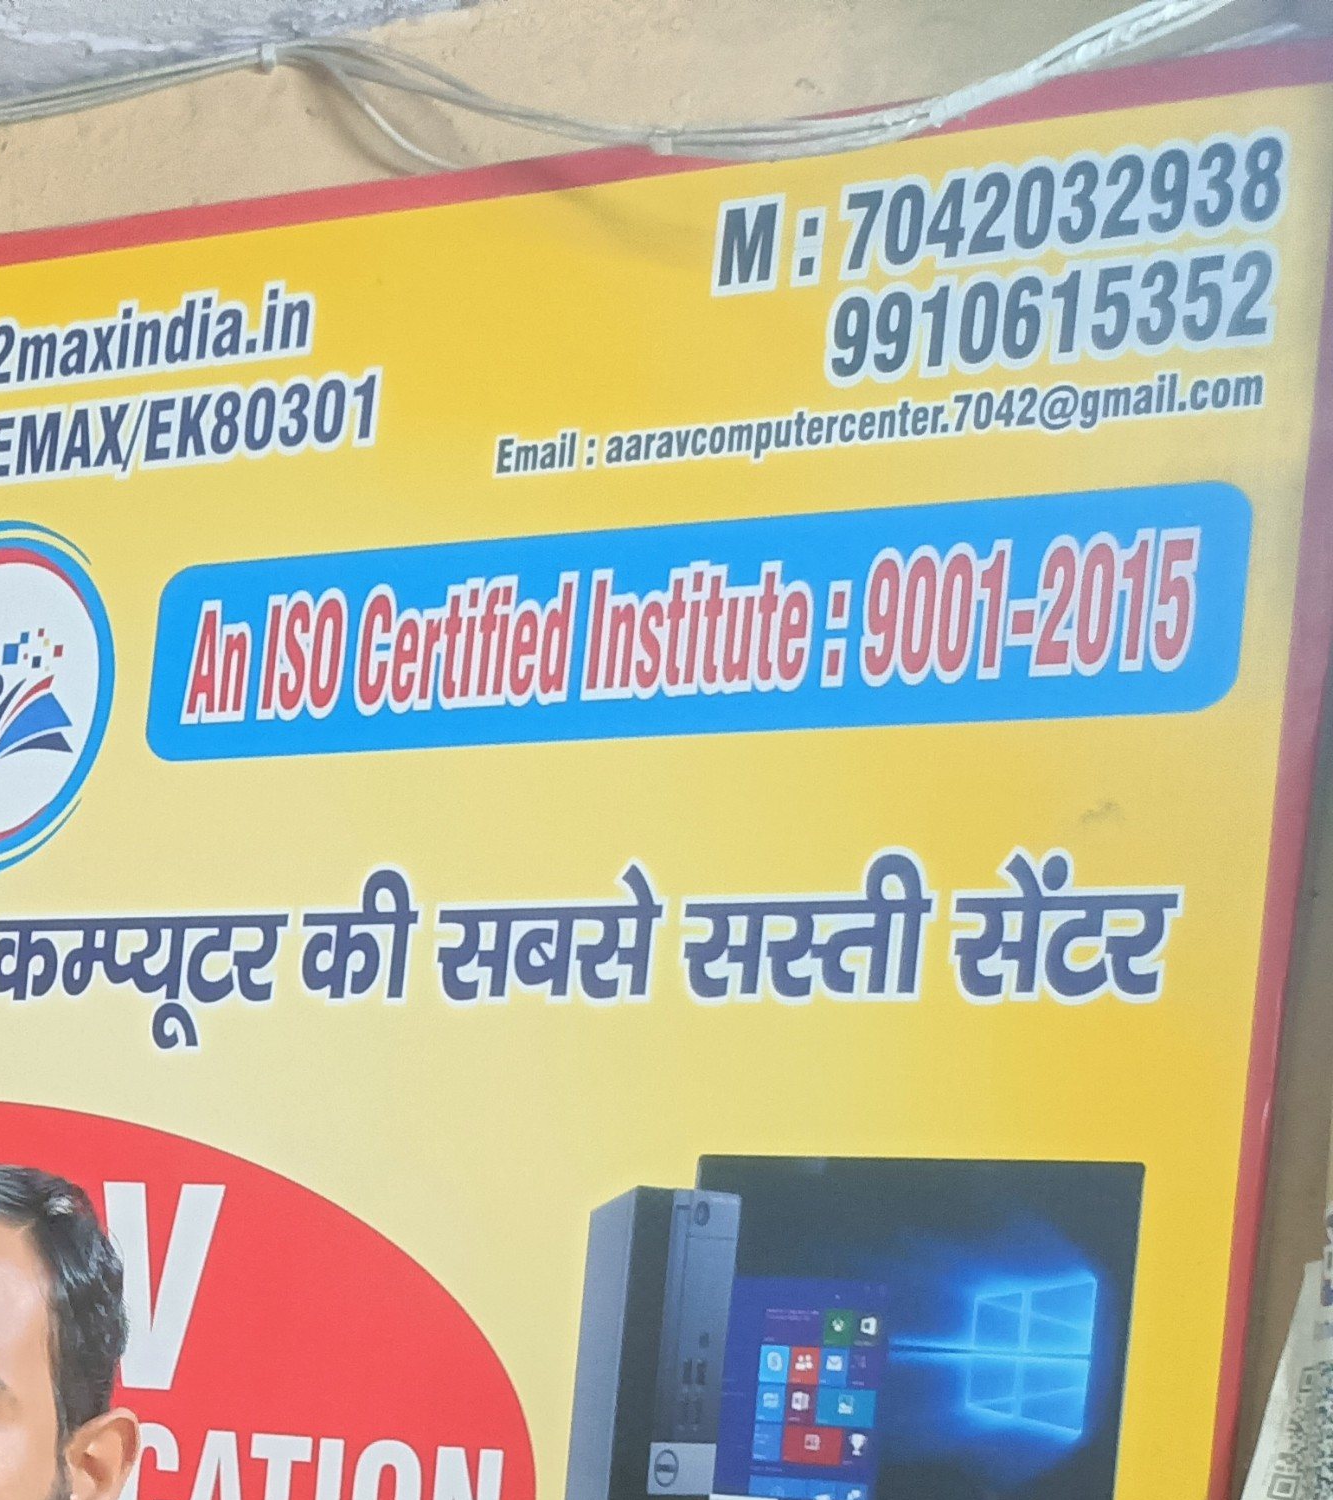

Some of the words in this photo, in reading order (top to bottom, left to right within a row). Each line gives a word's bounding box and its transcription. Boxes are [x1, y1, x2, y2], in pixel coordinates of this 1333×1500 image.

[716, 203, 776, 290] M
[847, 139, 1284, 274] 7042032938
[830, 254, 1275, 378] 9910615352
[496, 432, 577, 476] Email
[605, 373, 1264, 466] aaravcomputercenter.7042@gmail.com
[183, 601, 248, 726] An
[262, 591, 343, 718] ISO
[354, 575, 569, 714] Certified
[583, 564, 809, 698] Institute
[864, 530, 1200, 685] 9001-2015
[302, 868, 417, 1000] की
[438, 864, 663, 1001] सबसे
[684, 852, 932, 1000] सस्ती
[954, 850, 1179, 998] सेंटर
